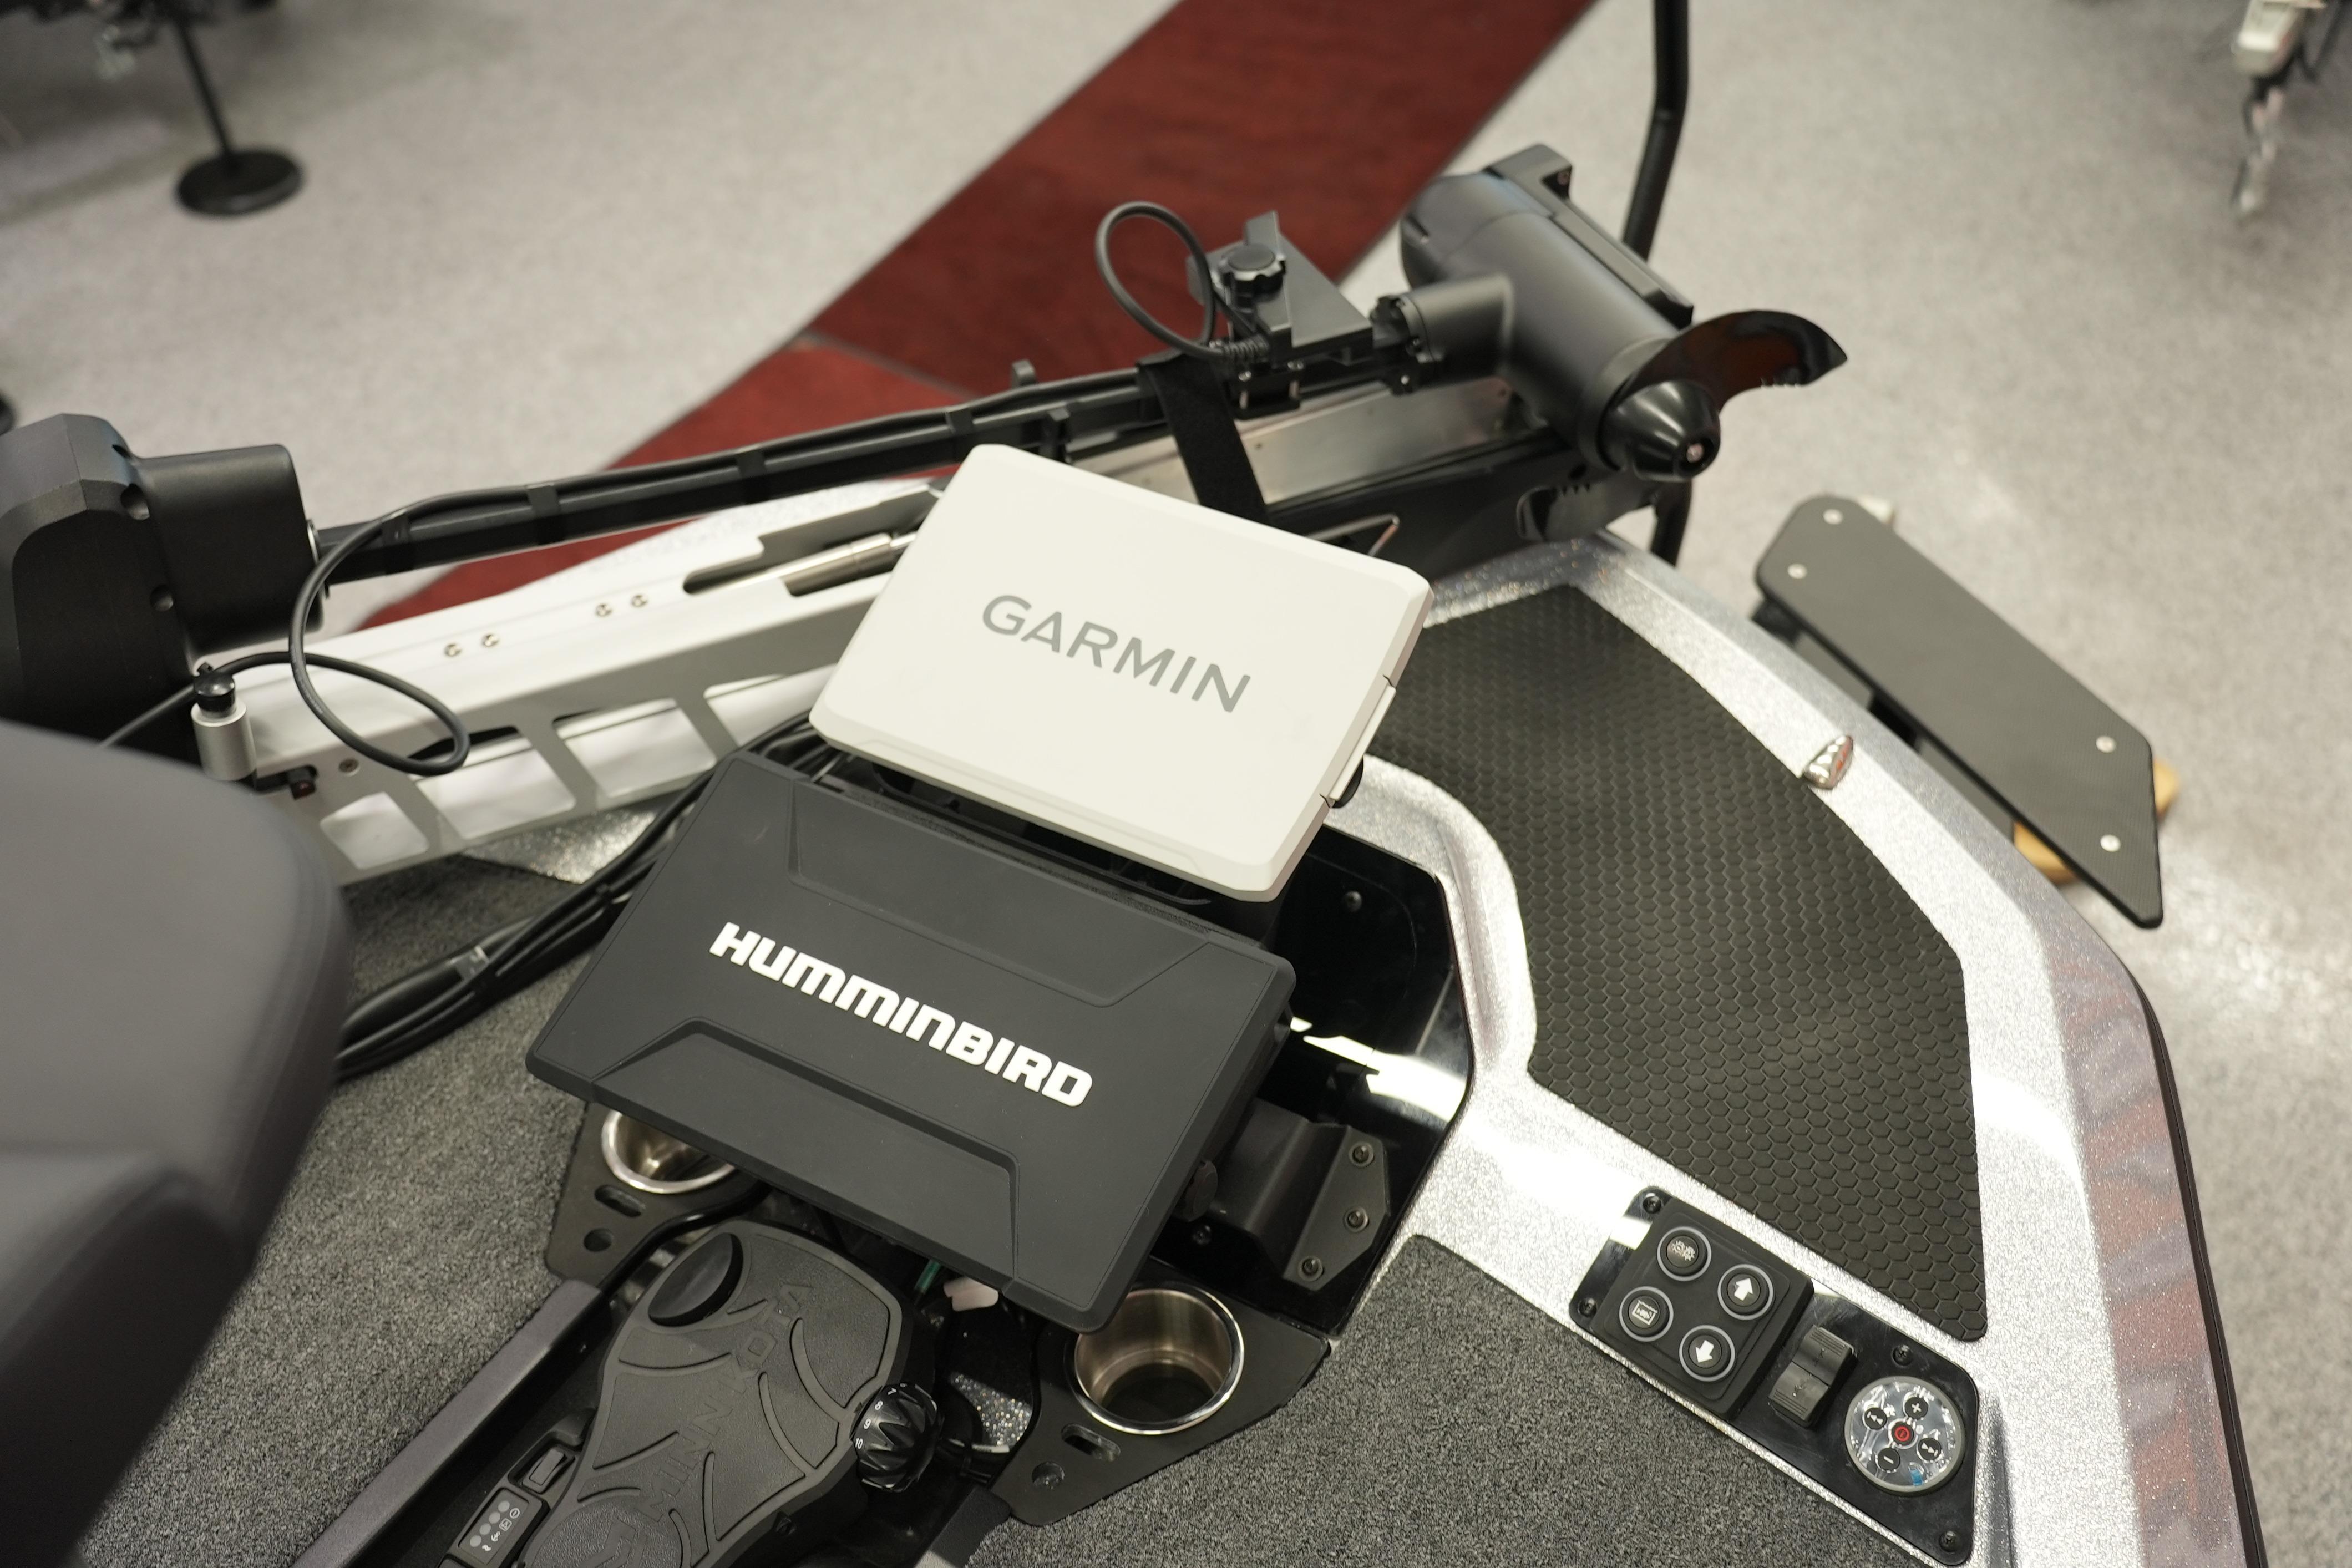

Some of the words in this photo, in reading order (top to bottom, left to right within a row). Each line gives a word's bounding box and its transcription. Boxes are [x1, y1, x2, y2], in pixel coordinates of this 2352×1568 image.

[982, 595, 1250, 712] GARMIN
[709, 922, 1093, 1107] HUMMINBIRD
[636, 1394, 733, 1522] MINN
[718, 1283, 814, 1393] KOTA
[864, 1418, 871, 1429] 9
[875, 1400, 883, 1410] 8
[855, 1438, 863, 1449] 10
